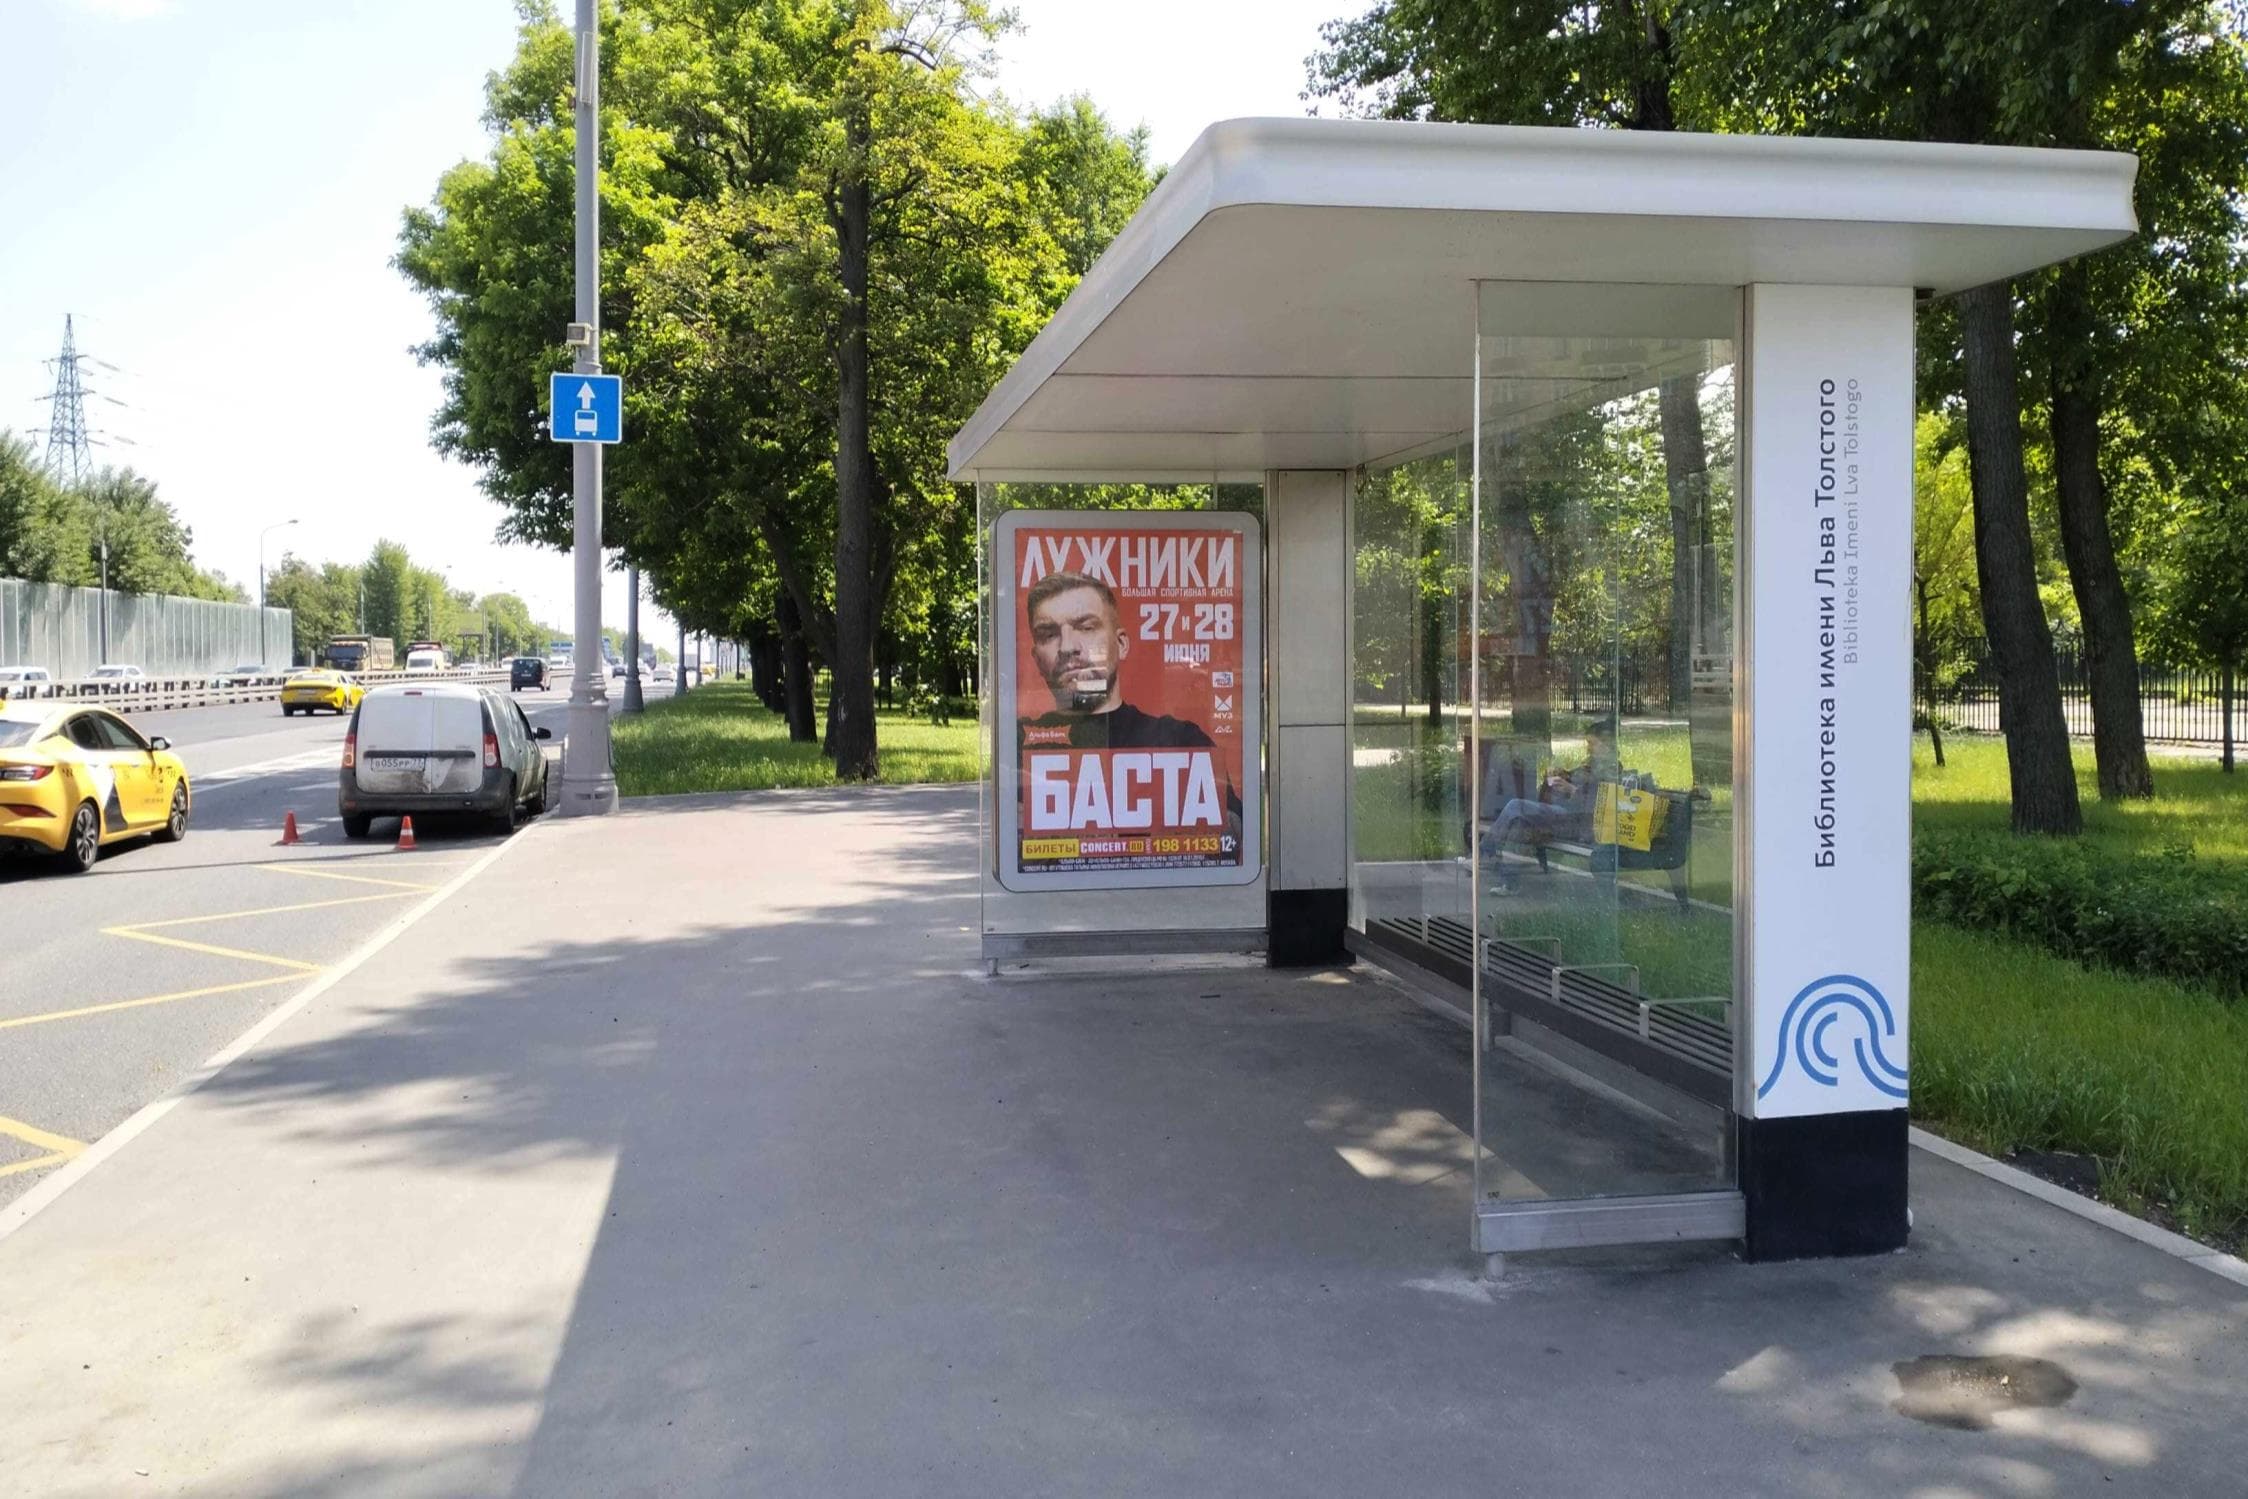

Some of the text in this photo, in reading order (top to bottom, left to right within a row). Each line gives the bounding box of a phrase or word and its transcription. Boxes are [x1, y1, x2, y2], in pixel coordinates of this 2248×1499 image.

[1843, 378, 1862, 664] Biblioteka Imeni Lva Tolstogo
[1021, 536, 1234, 588] ЛУЖНИКИ
[1121, 588, 1234, 598] БОЛЬШАЯ СПОРТИВНАЯ АРЕНА
[1140, 603, 1180, 640] 27
[1194, 603, 1234, 640] 28
[1815, 378, 1836, 868] Библиотека имени Льва Толстого
[1164, 643, 1210, 664] ИЮНЯ
[1031, 752, 1222, 830] БАСТА
[1025, 842, 1077, 855] БИЛЕТЫ
[1153, 838, 1180, 852] 198
[1183, 837, 1219, 851] 1133
[1220, 835, 1237, 852] 12+
